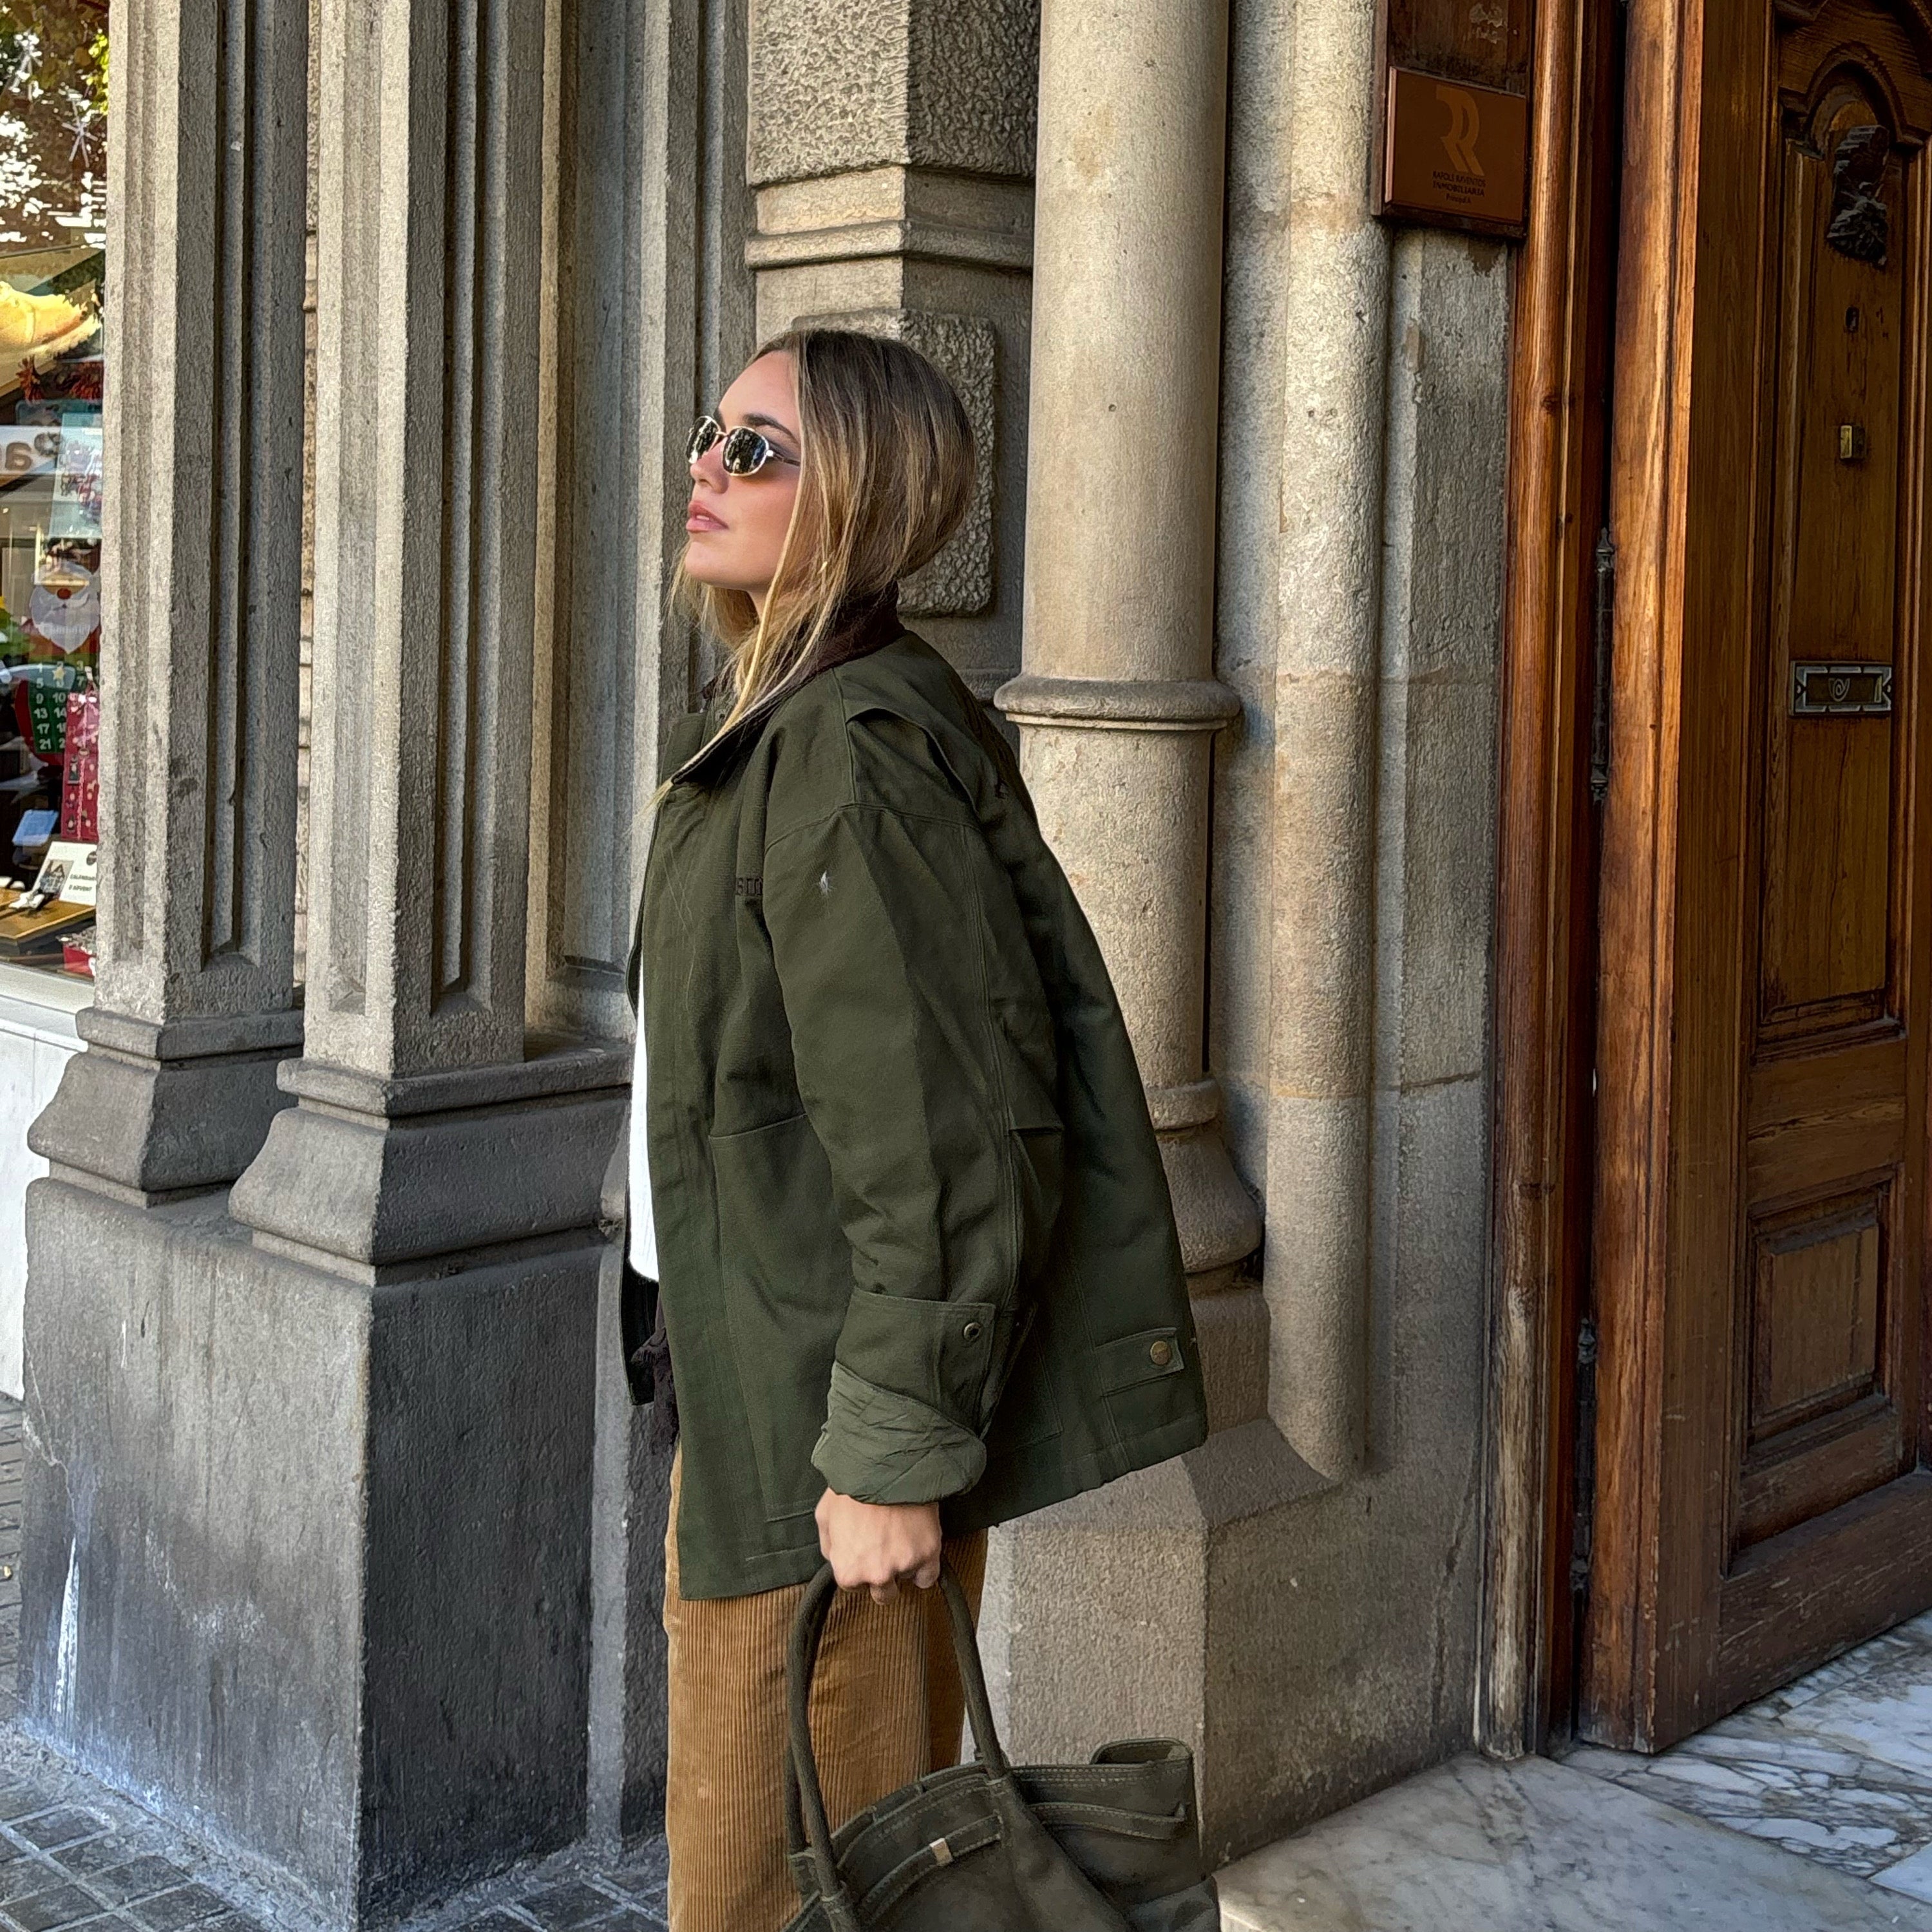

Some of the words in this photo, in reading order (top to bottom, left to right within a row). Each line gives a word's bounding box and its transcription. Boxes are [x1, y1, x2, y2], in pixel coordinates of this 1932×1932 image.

[1432, 180, 1485, 197] INMOBILIARIA
[36, 677, 44, 688] 5
[76, 676, 84, 687] 7
[52, 692, 66, 703] 10
[33, 707, 48, 719] 13
[37, 723, 50, 734] 17
[39, 739, 52, 750] 21
